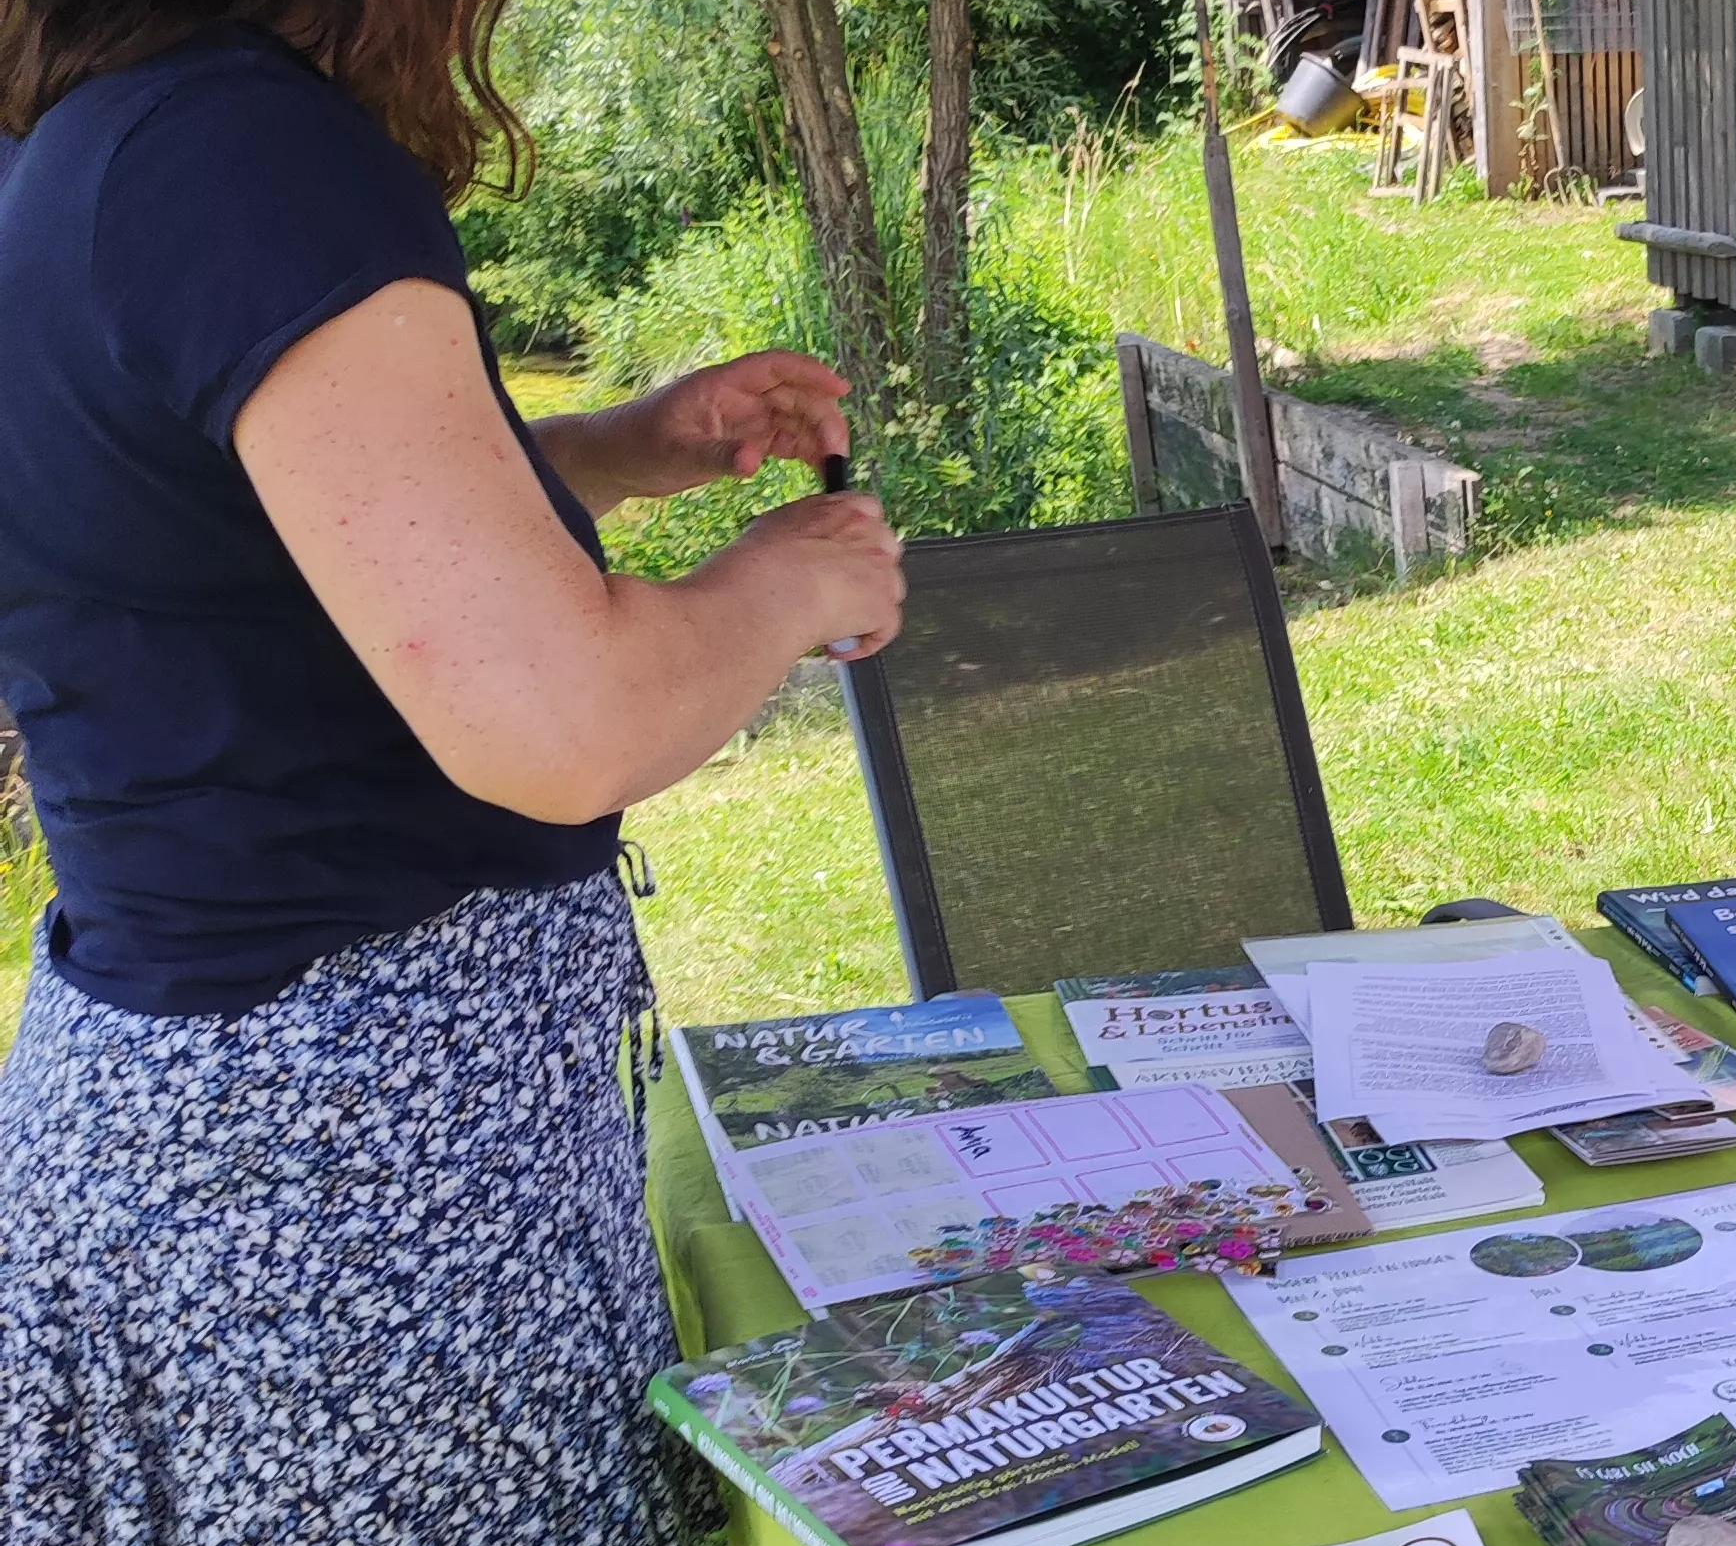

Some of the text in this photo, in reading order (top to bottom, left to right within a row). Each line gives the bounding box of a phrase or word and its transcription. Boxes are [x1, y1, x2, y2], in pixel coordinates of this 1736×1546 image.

[1627, 888, 1702, 905] Wird
[1098, 1014, 1295, 1040] & Lebensin
[1103, 1000, 1274, 1024] Hortus
[714, 1018, 869, 1051] NATUR
[754, 1025, 987, 1066] & GARTEN
[830, 1356, 1175, 1480] PERMAKULTUR
[861, 1470, 918, 1507] UND
[906, 1370, 1247, 1489] NATURGARTEN
